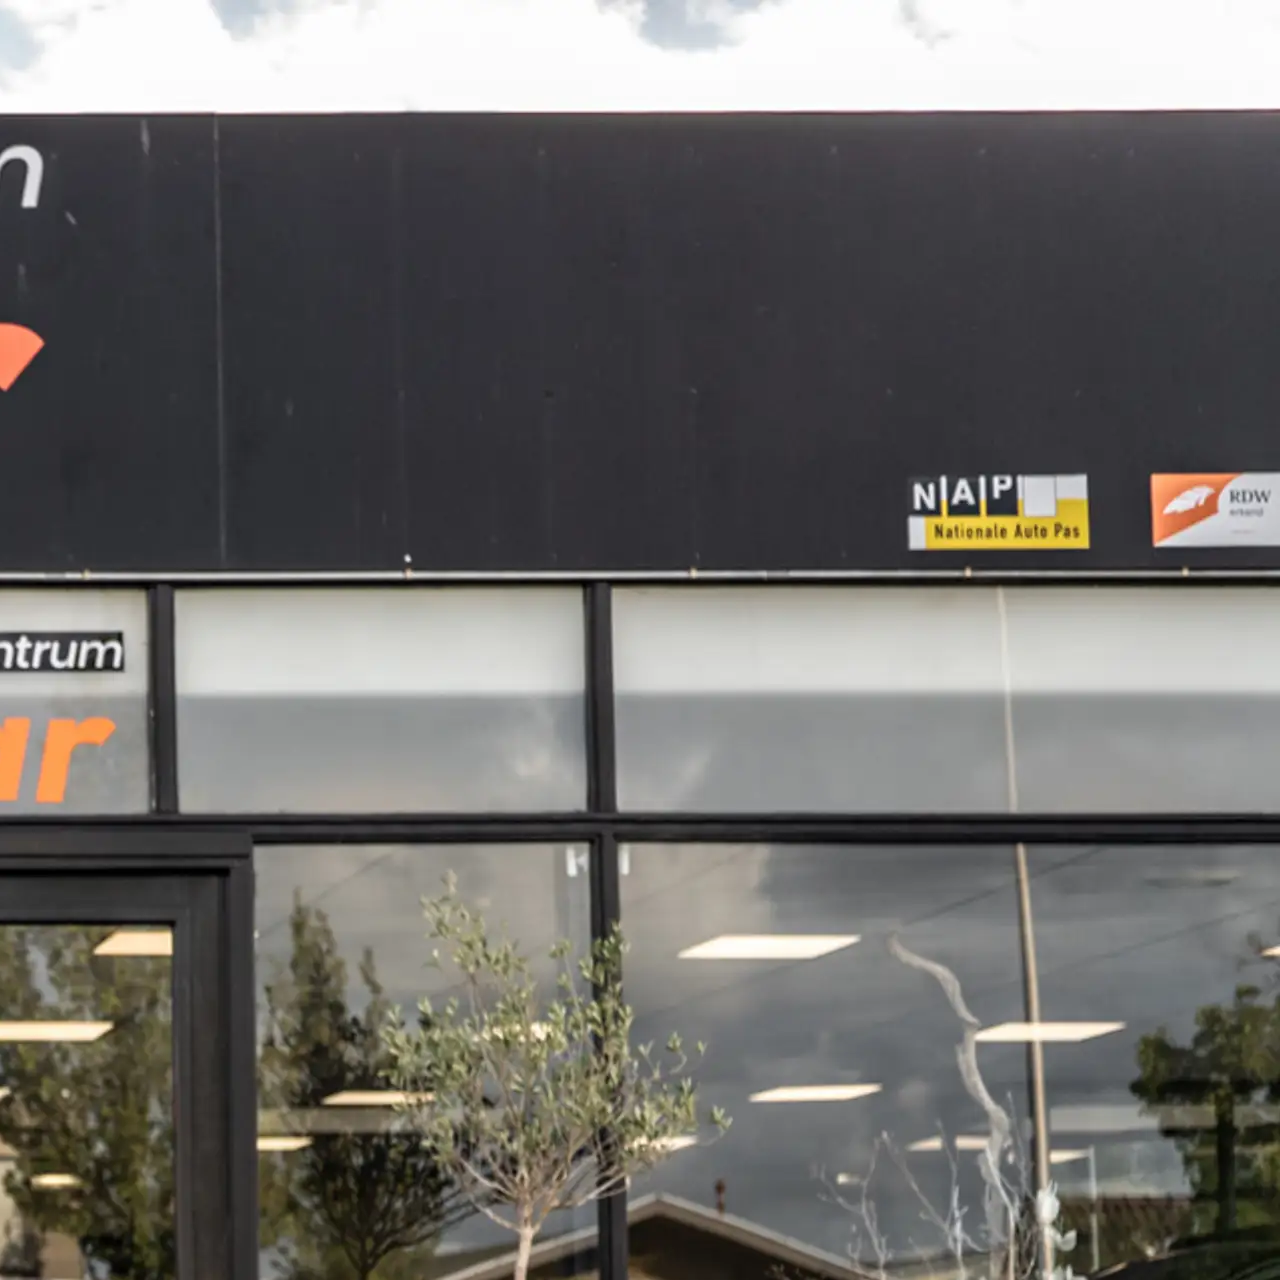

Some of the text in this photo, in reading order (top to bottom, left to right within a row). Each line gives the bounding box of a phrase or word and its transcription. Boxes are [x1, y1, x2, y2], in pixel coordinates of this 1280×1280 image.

[1229, 488, 1271, 504] RDW
[934, 522, 1081, 539] Nationale Auto Pas
